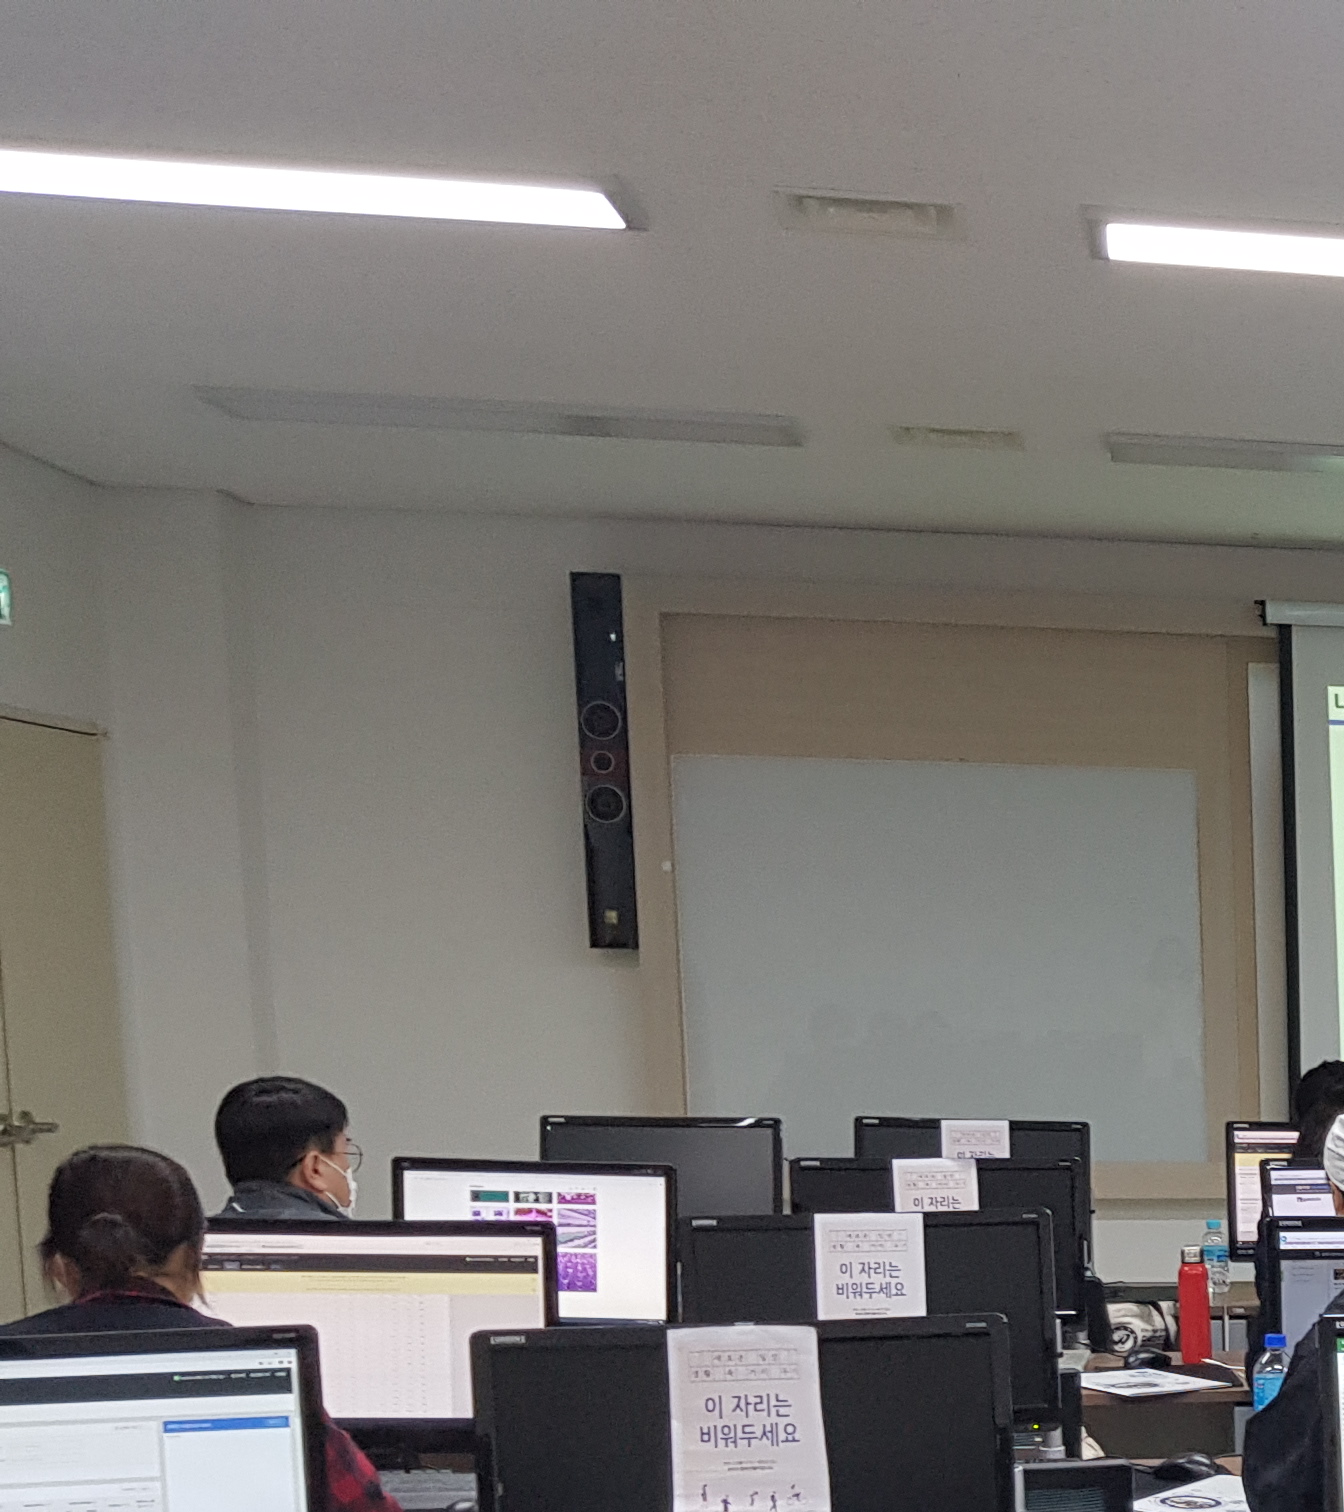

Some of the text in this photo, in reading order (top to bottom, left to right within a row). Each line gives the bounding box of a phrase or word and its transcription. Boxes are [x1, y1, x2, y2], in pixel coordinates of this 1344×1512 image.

[913, 1196, 962, 1210] 이 자리는
[840, 1261, 902, 1279] 이 자리는
[836, 1282, 907, 1299] 비워두세요
[704, 1393, 792, 1420] 이 자리는
[699, 1422, 801, 1449] 비워두세요
